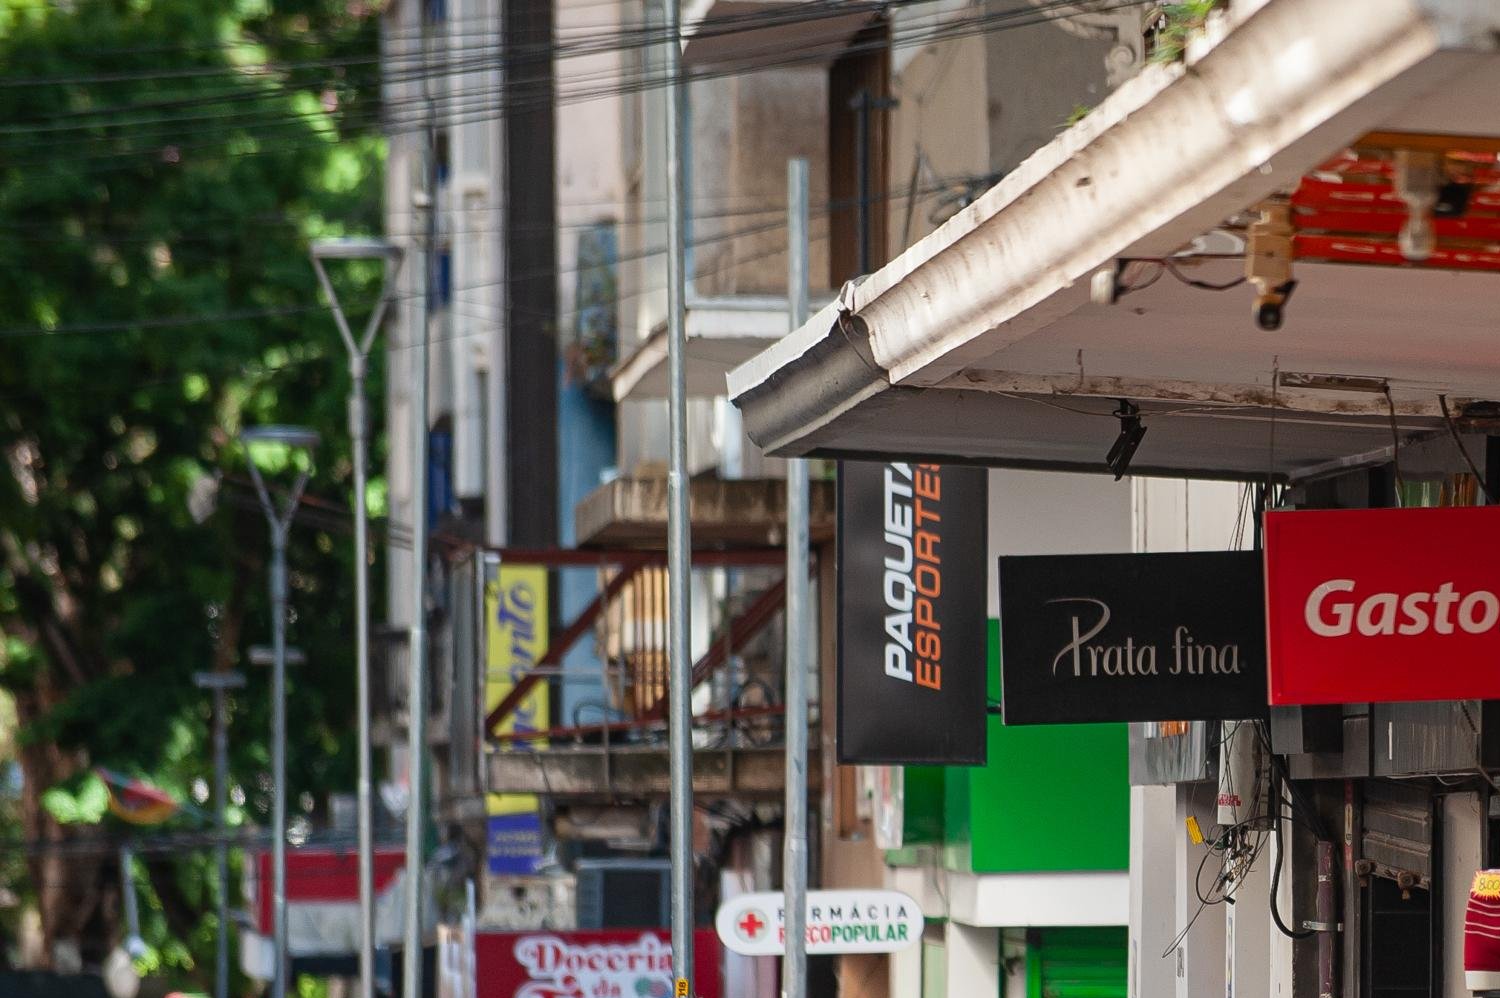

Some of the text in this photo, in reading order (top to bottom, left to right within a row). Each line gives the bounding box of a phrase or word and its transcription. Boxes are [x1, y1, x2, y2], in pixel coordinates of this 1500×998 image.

[1045, 597, 1240, 677] Prata fina
[777, 903, 908, 920] FRMÁCIA
